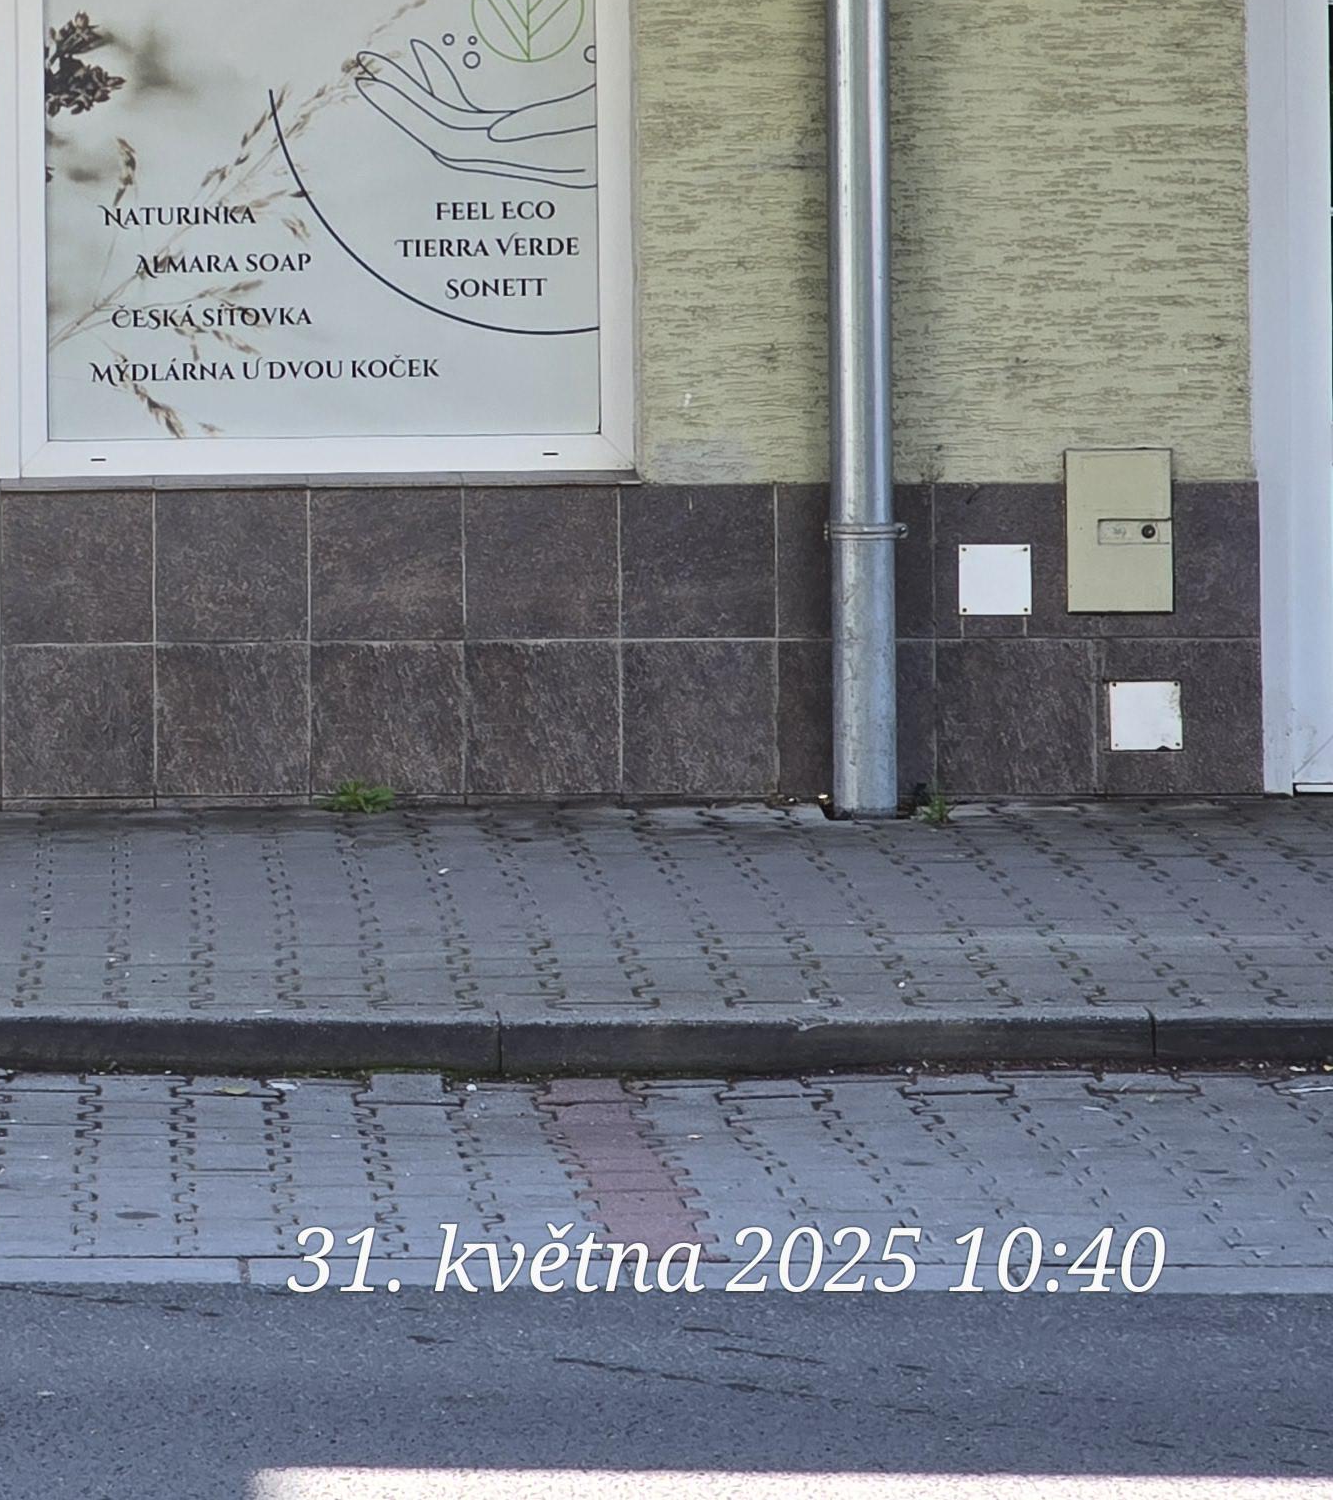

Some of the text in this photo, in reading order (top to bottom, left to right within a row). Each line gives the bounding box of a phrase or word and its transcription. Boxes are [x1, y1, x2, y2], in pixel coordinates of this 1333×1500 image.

[99, 204, 257, 230] NATURINKA
[435, 200, 556, 221] FEEL ECO
[394, 231, 581, 258] TIERRA VERDE
[135, 253, 312, 279] ALMARA SOAP
[444, 277, 549, 300] SONETT
[111, 304, 195, 331] ČESKÁ
[88, 354, 440, 386] MÝDLÁRNA U DVOU KOČEK
